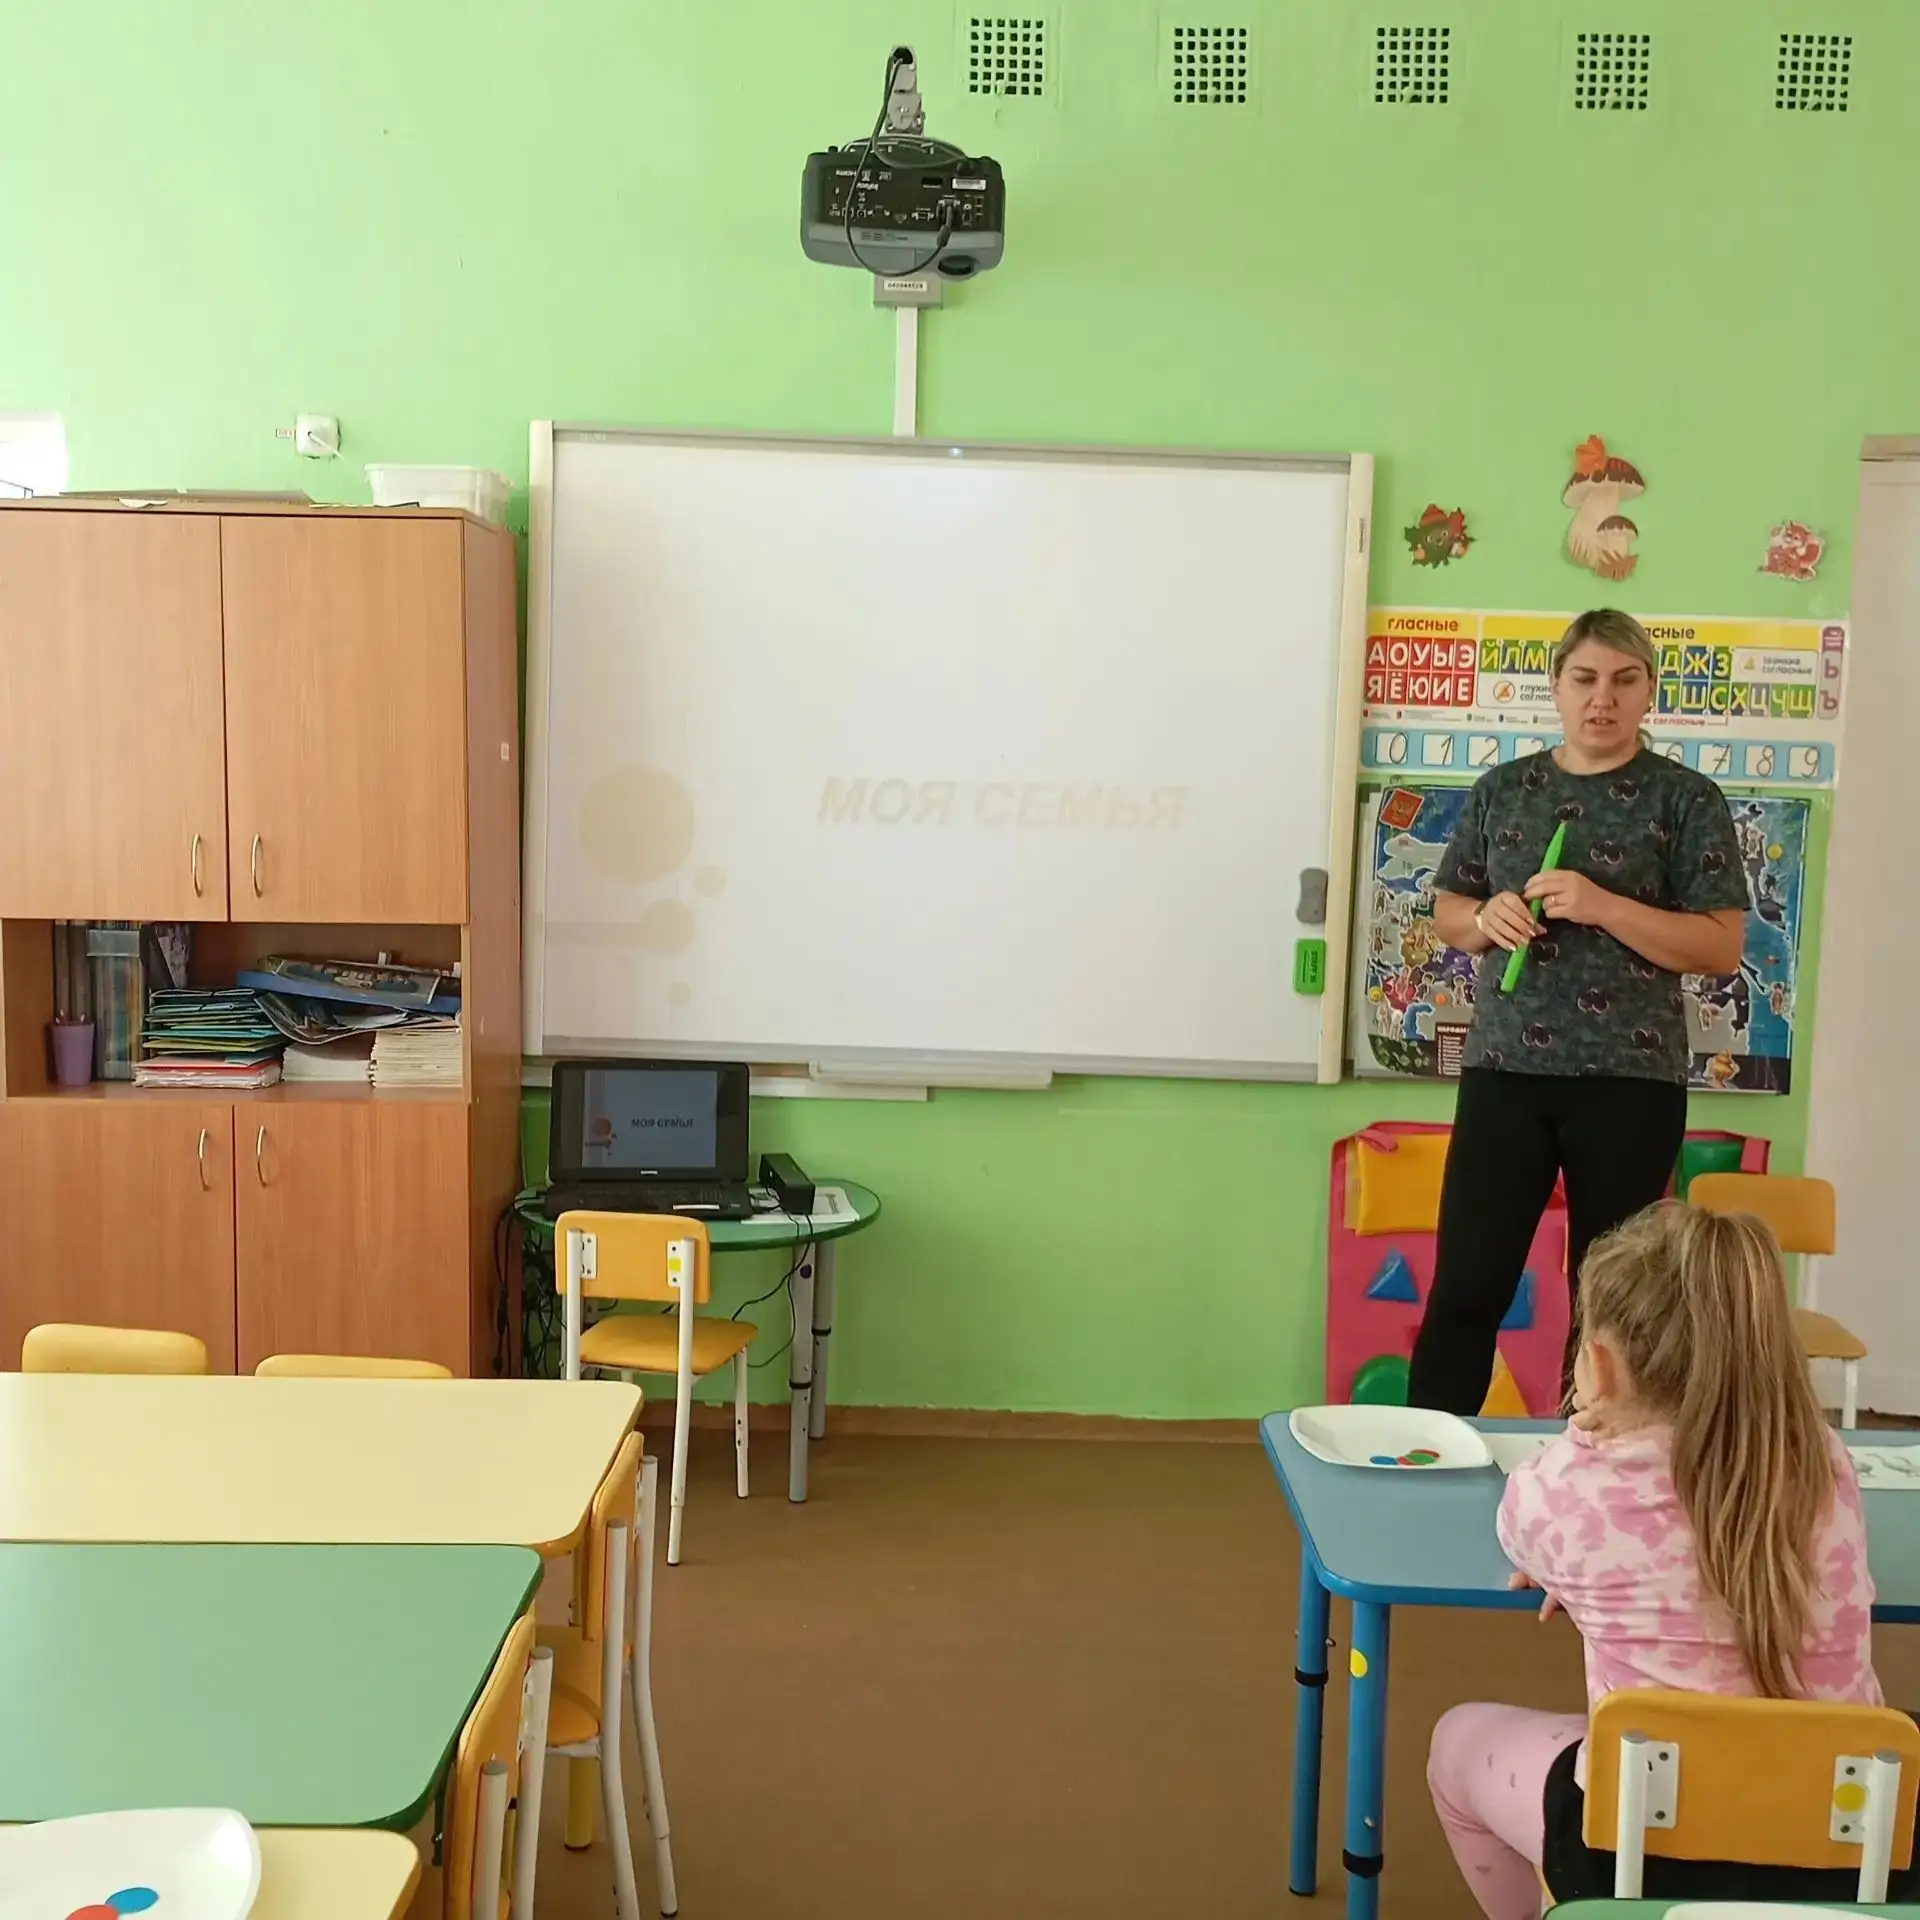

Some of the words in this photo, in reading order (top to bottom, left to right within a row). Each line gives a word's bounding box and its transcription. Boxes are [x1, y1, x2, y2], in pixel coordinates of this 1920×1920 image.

[1387, 617, 1459, 632] гласные
[1712, 743, 1732, 775] 7
[1757, 745, 1775, 777] 8
[1801, 746, 1821, 779] 9
[816, 776, 958, 829] МОЯ
[974, 781, 1190, 833] СЕМЬЯ
[631, 1118, 656, 1128] МОЯ
